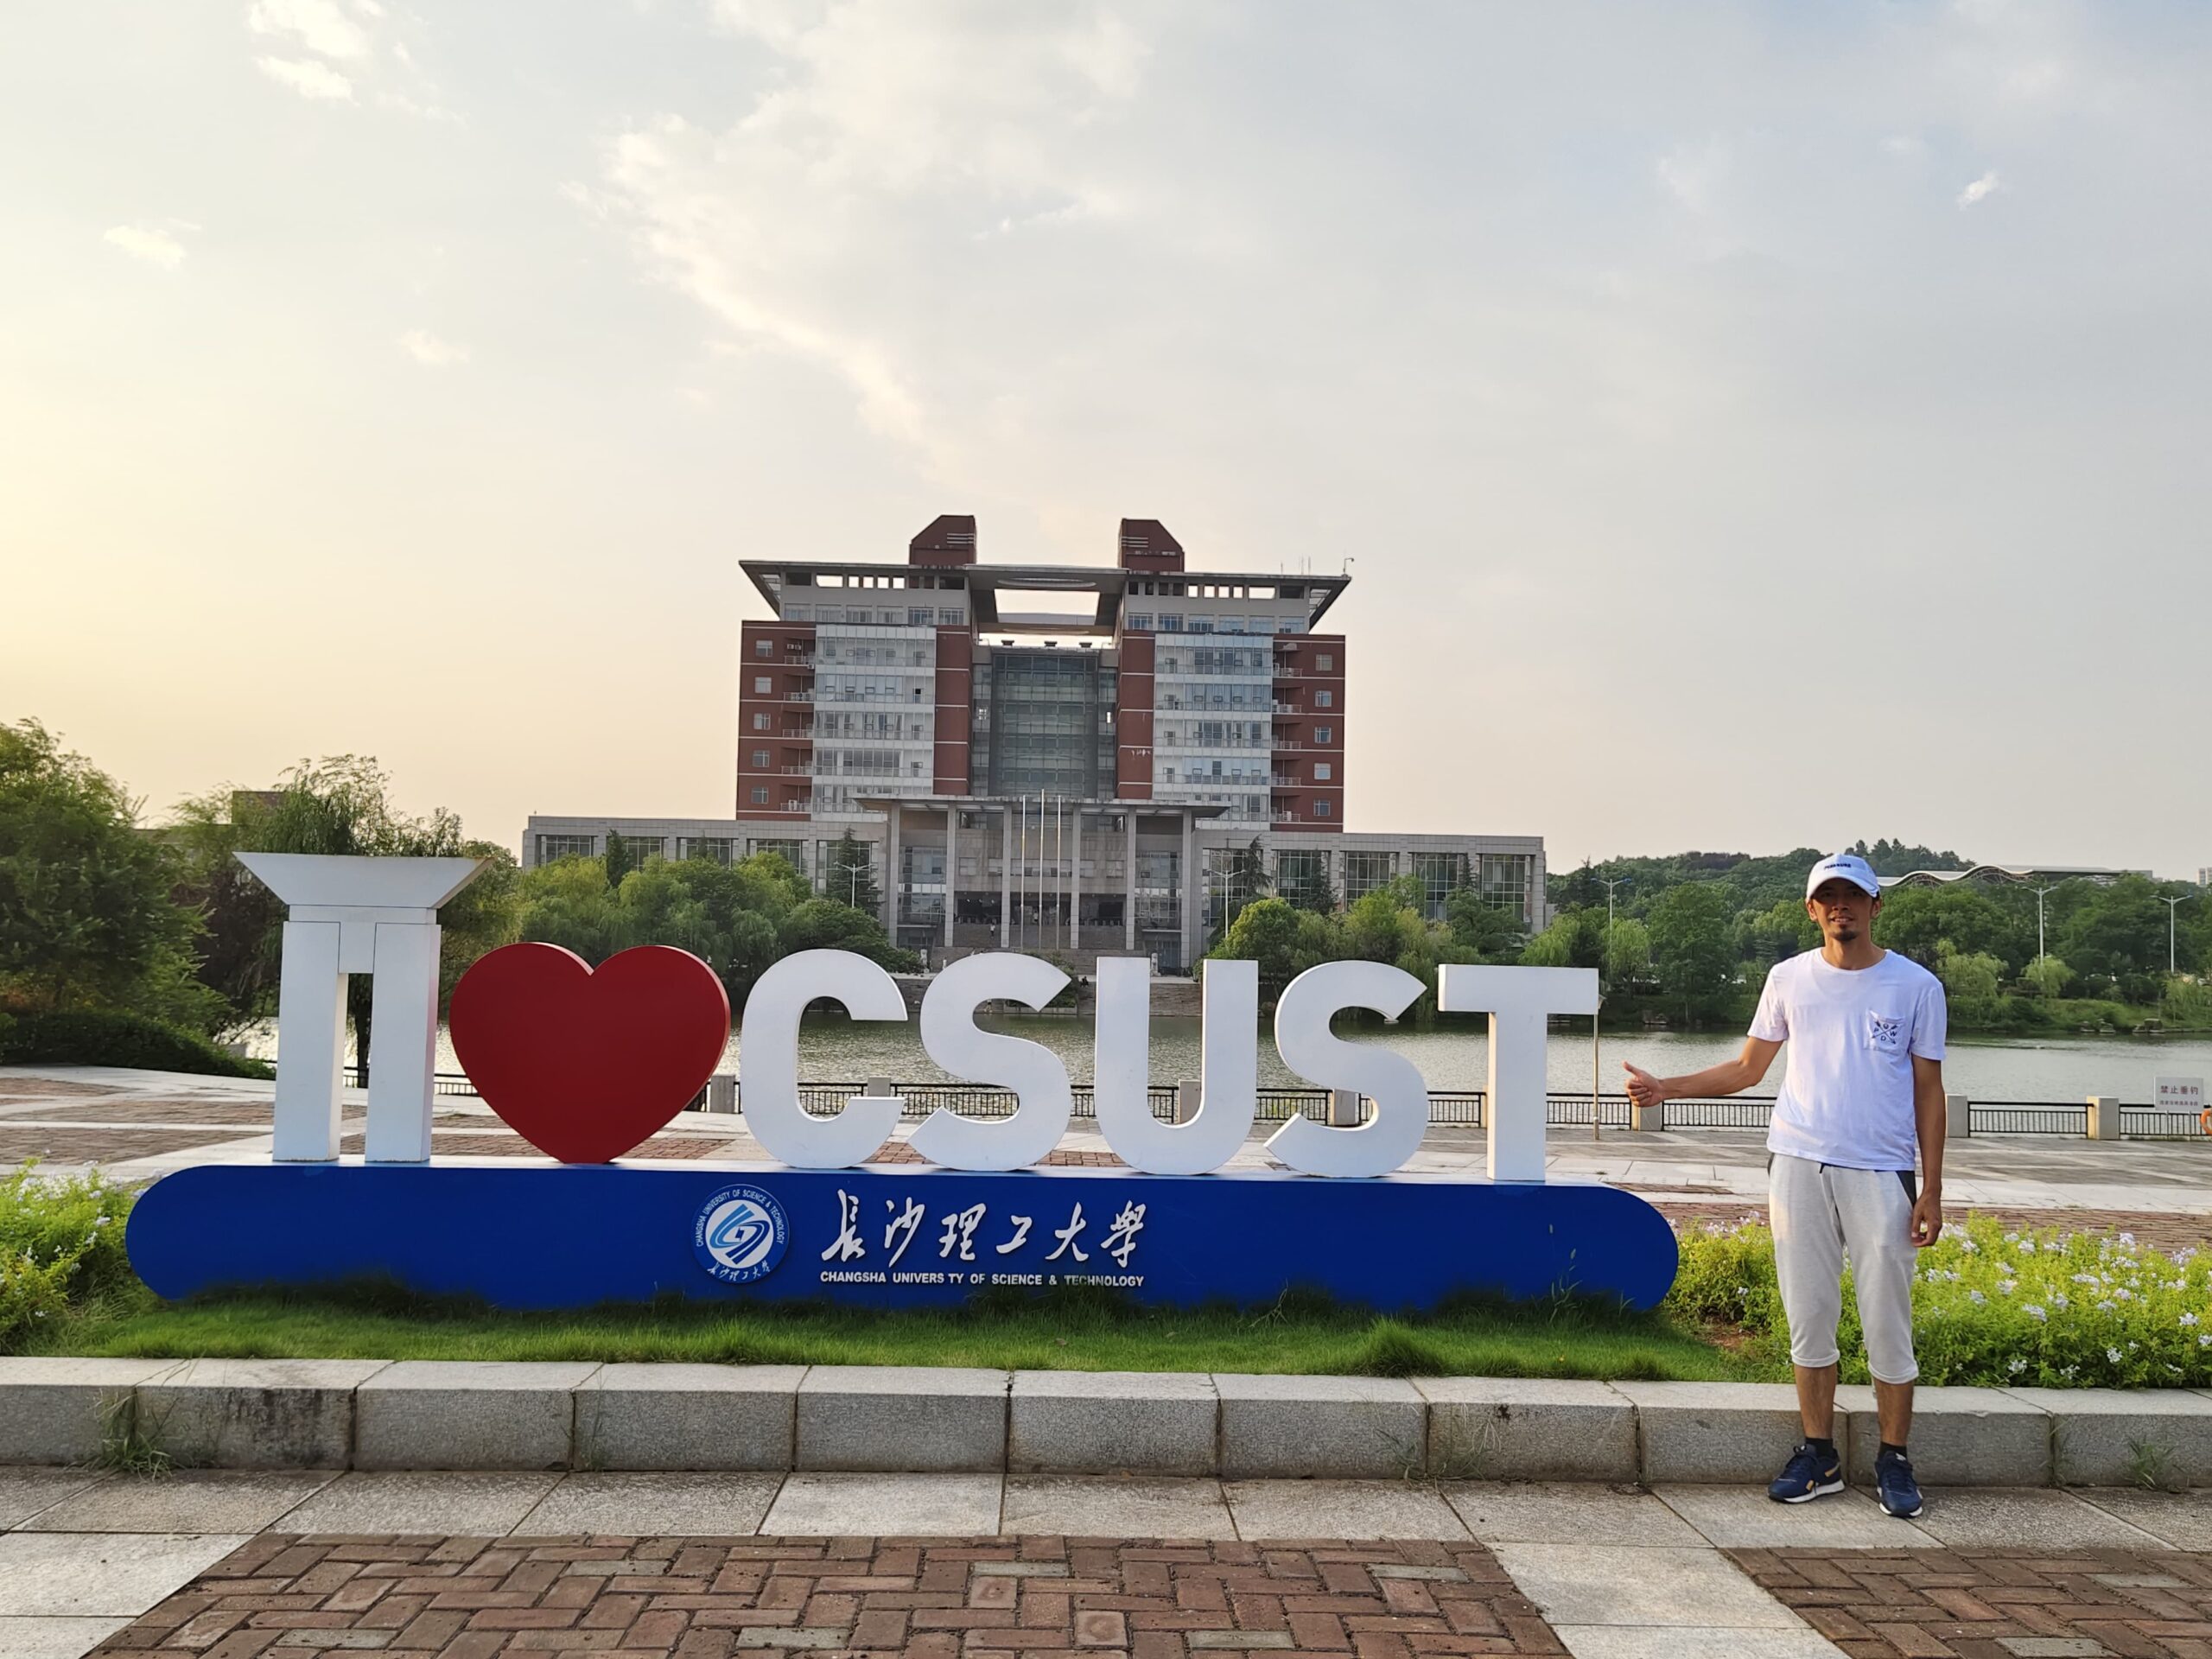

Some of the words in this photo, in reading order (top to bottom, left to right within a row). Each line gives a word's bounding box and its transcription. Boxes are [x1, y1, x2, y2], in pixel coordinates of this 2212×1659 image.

[741, 948, 1599, 1182] CSUST
[696, 1215, 707, 1247] CHANGSHA
[702, 1191, 730, 1215] UNIVERSITY
[732, 1189, 741, 1198] OF
[742, 1189, 766, 1204] SCIENCE
[770, 1205, 785, 1244] TECHNOLOGY
[820, 1271, 887, 1283] CHANGSHA
[969, 1273, 985, 1284] OF
[992, 1274, 1042, 1286] SCIENCE
[1049, 1274, 1058, 1286] &
[1064, 1274, 1144, 1287] TECHNOLOGY
